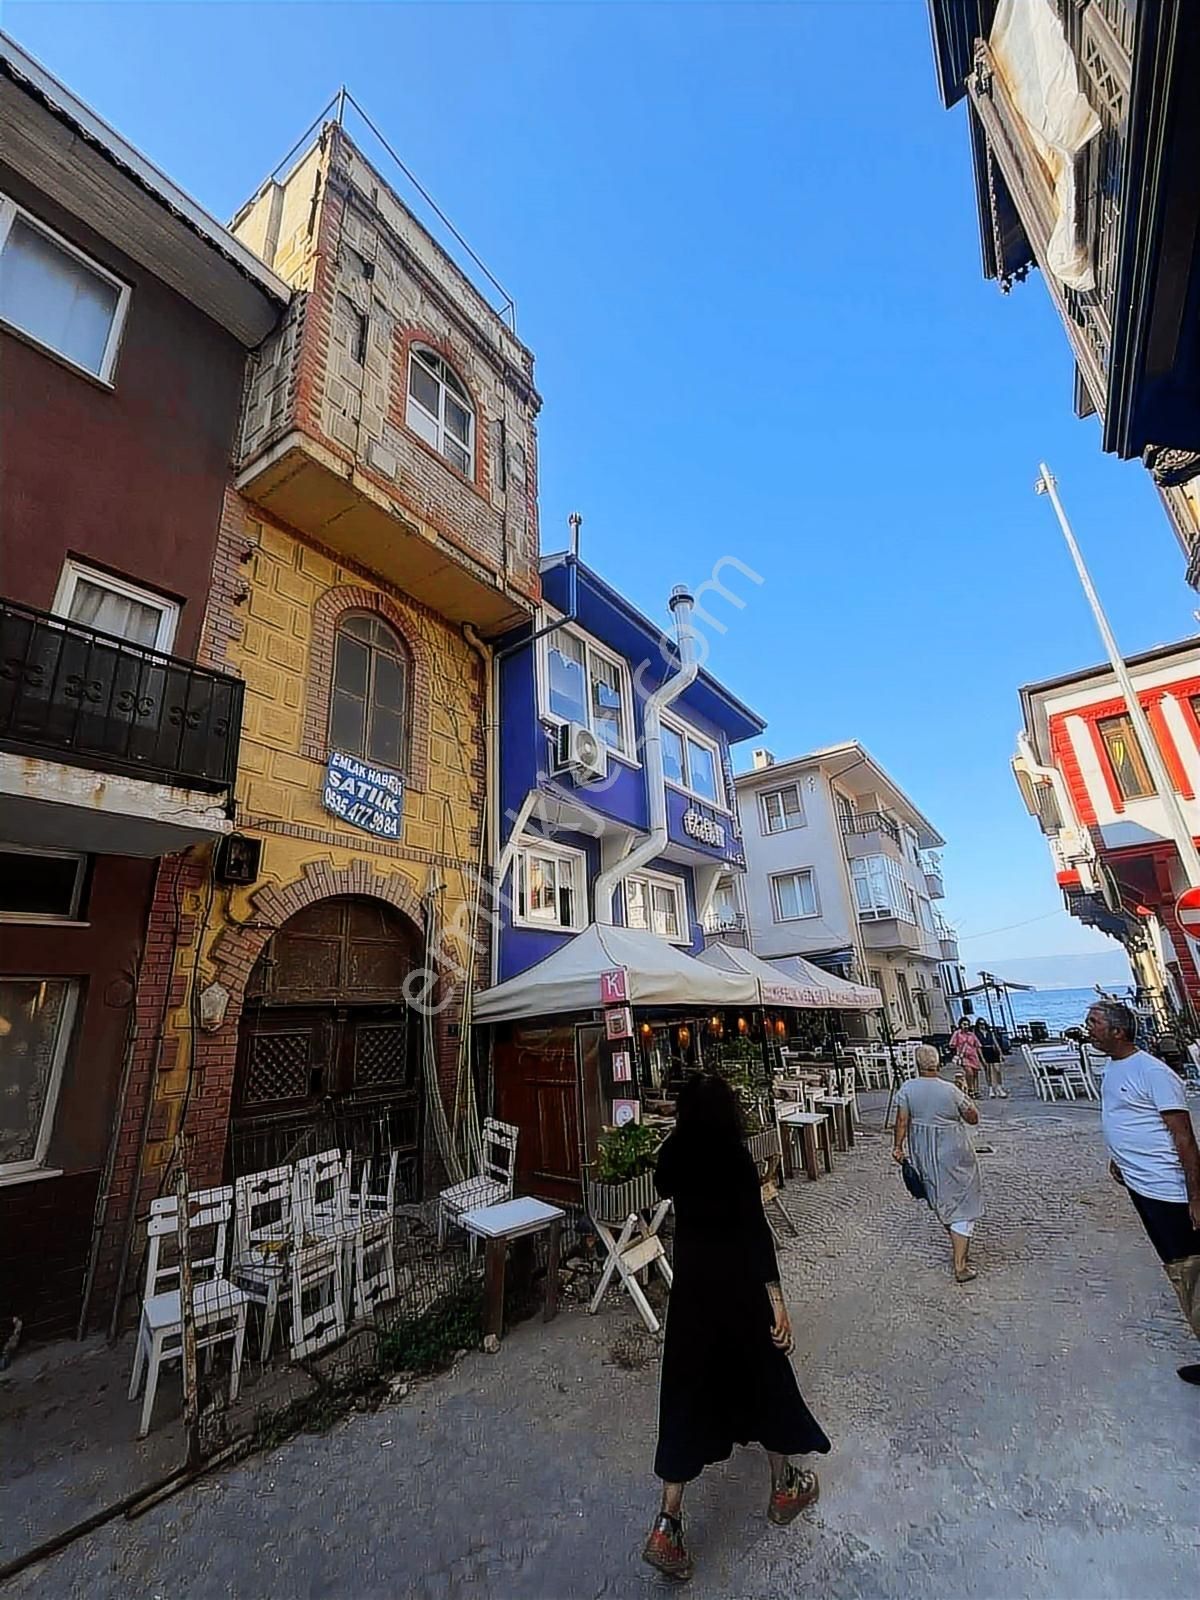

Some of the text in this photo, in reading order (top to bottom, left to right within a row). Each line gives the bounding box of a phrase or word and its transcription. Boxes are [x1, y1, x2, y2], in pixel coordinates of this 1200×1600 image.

[332, 753, 366, 778] EMLAK
[328, 770, 398, 814] SATILIK
[347, 803, 373, 825] 477
